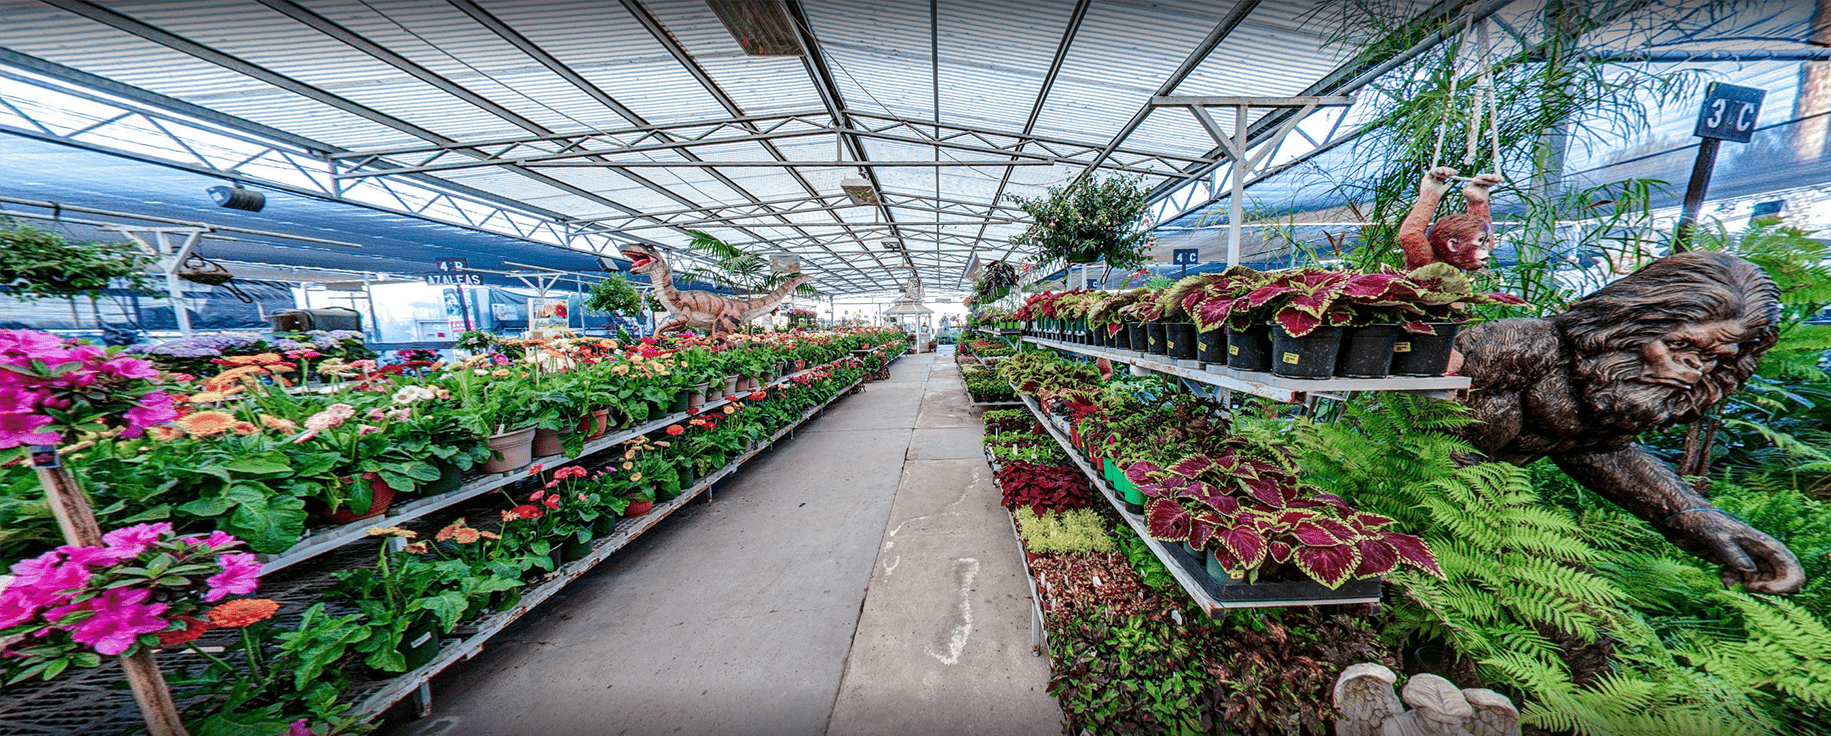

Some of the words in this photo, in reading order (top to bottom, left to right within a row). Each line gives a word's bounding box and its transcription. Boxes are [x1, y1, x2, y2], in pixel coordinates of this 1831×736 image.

[1707, 98, 1726, 128] 3
[1737, 103, 1755, 131] C
[1176, 253, 1183, 262] 4
[1189, 252, 1196, 262] C
[440, 261, 448, 271] 4
[427, 274, 481, 285] AZALEAS
